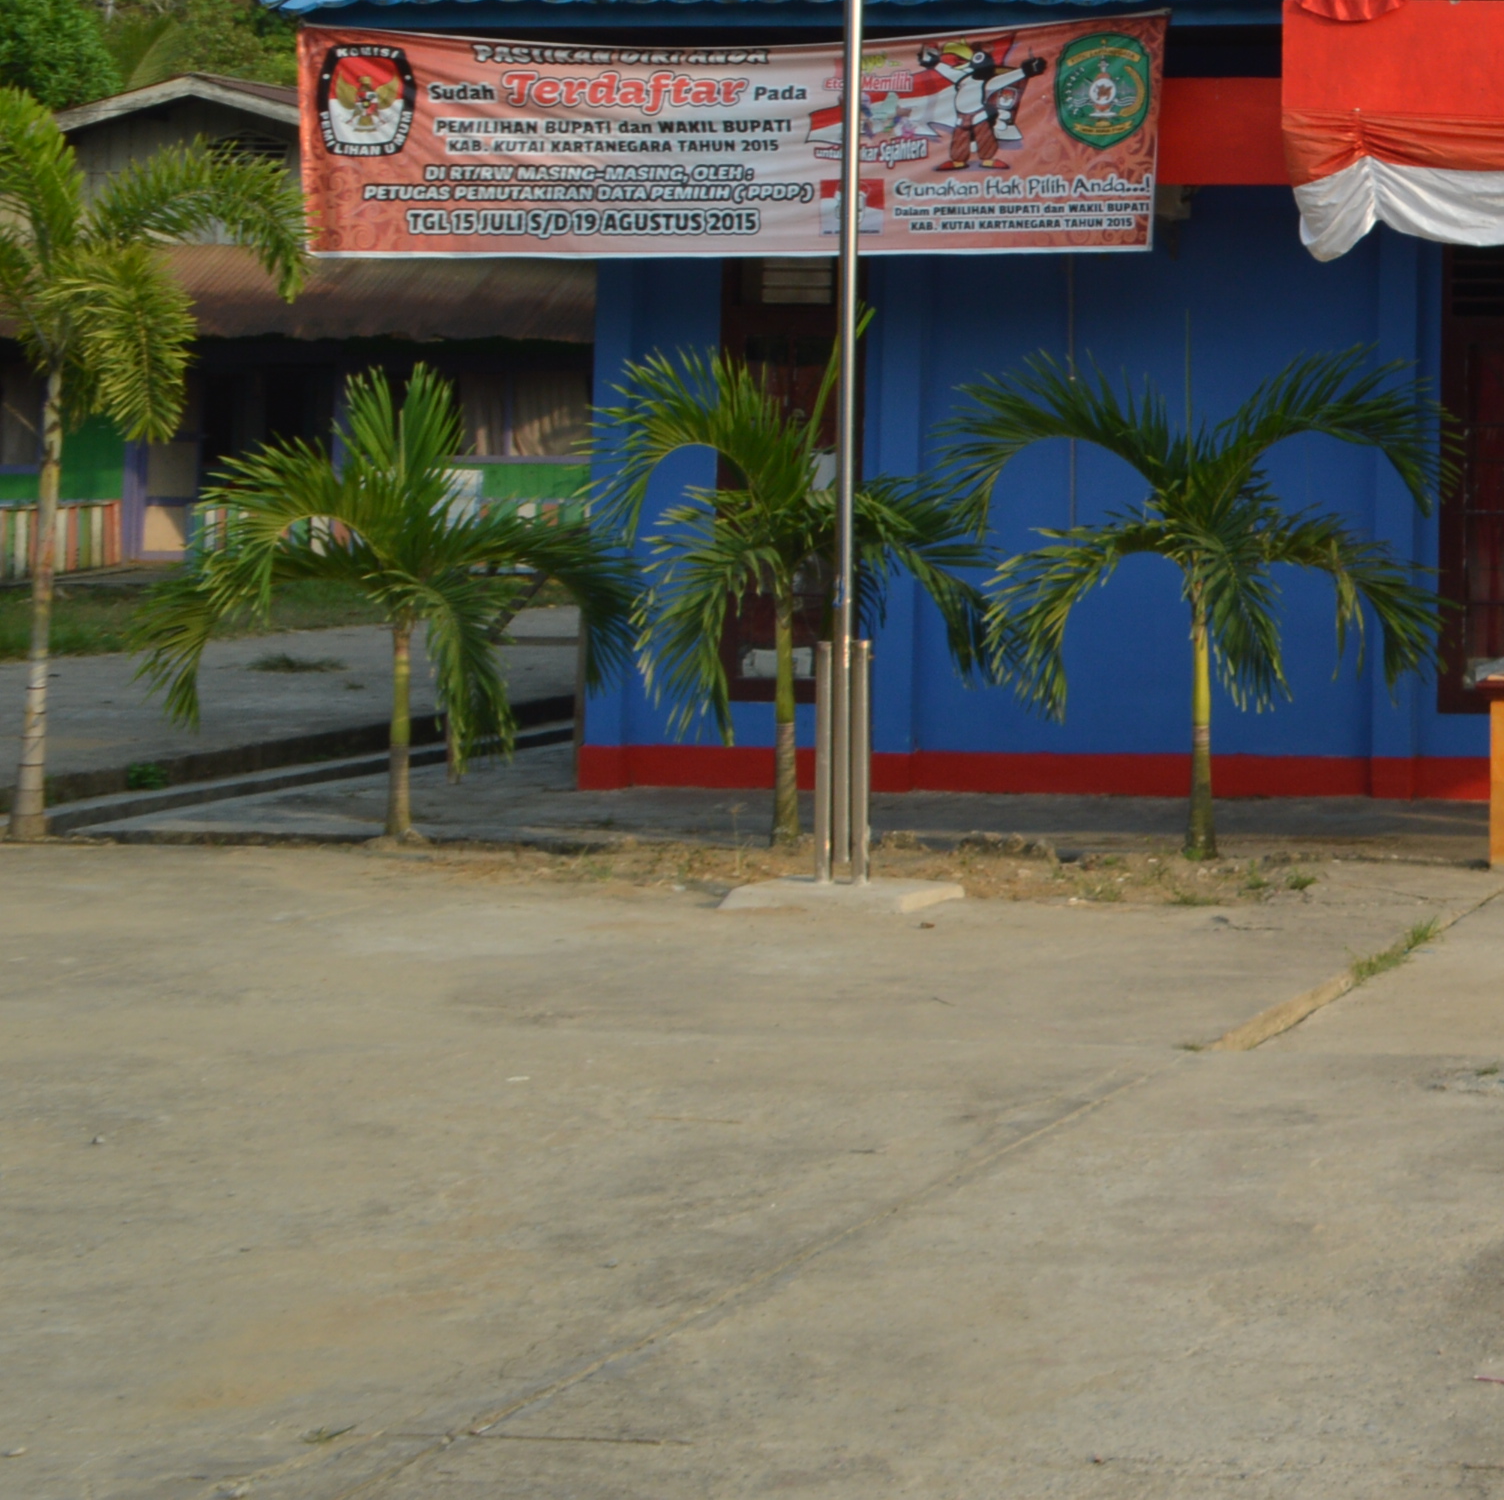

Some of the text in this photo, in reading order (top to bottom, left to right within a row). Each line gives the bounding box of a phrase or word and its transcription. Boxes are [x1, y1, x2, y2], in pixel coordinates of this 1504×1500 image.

[336, 47, 400, 59] KOMISI
[861, 71, 913, 91] Memilih
[430, 70, 807, 116] Sudah Terdaftar Pada
[436, 119, 791, 134] PEMILIHAN BUPATI dan WAKIL BUPATI
[449, 139, 779, 152] KAB. KUTAI KARTANEGARA TAHUN 2015
[815, 146, 844, 159] untu
[880, 138, 928, 167] Sejahtera
[424, 164, 445, 181] DI
[450, 164, 514, 181] RT/RW
[364, 184, 450, 201] PETUGAS
[454, 184, 593, 201] PEMUTAKIRAN
[597, 184, 648, 201] DATA
[650, 184, 732, 201] PEMILIH
[895, 179, 979, 197] Gunakan
[985, 177, 1021, 195] Hak
[1028, 177, 1066, 195] Pilih
[895, 202, 1150, 216] Dalam PEMILIHAN BUPATI dan WAKIL BUPATI
[408, 211, 758, 236] TGL 15 JULI S/D 19 AGUSTUS 2015
[911, 217, 1132, 231] KAB. KUTAI KARTANEGARA TAHUN 2015
